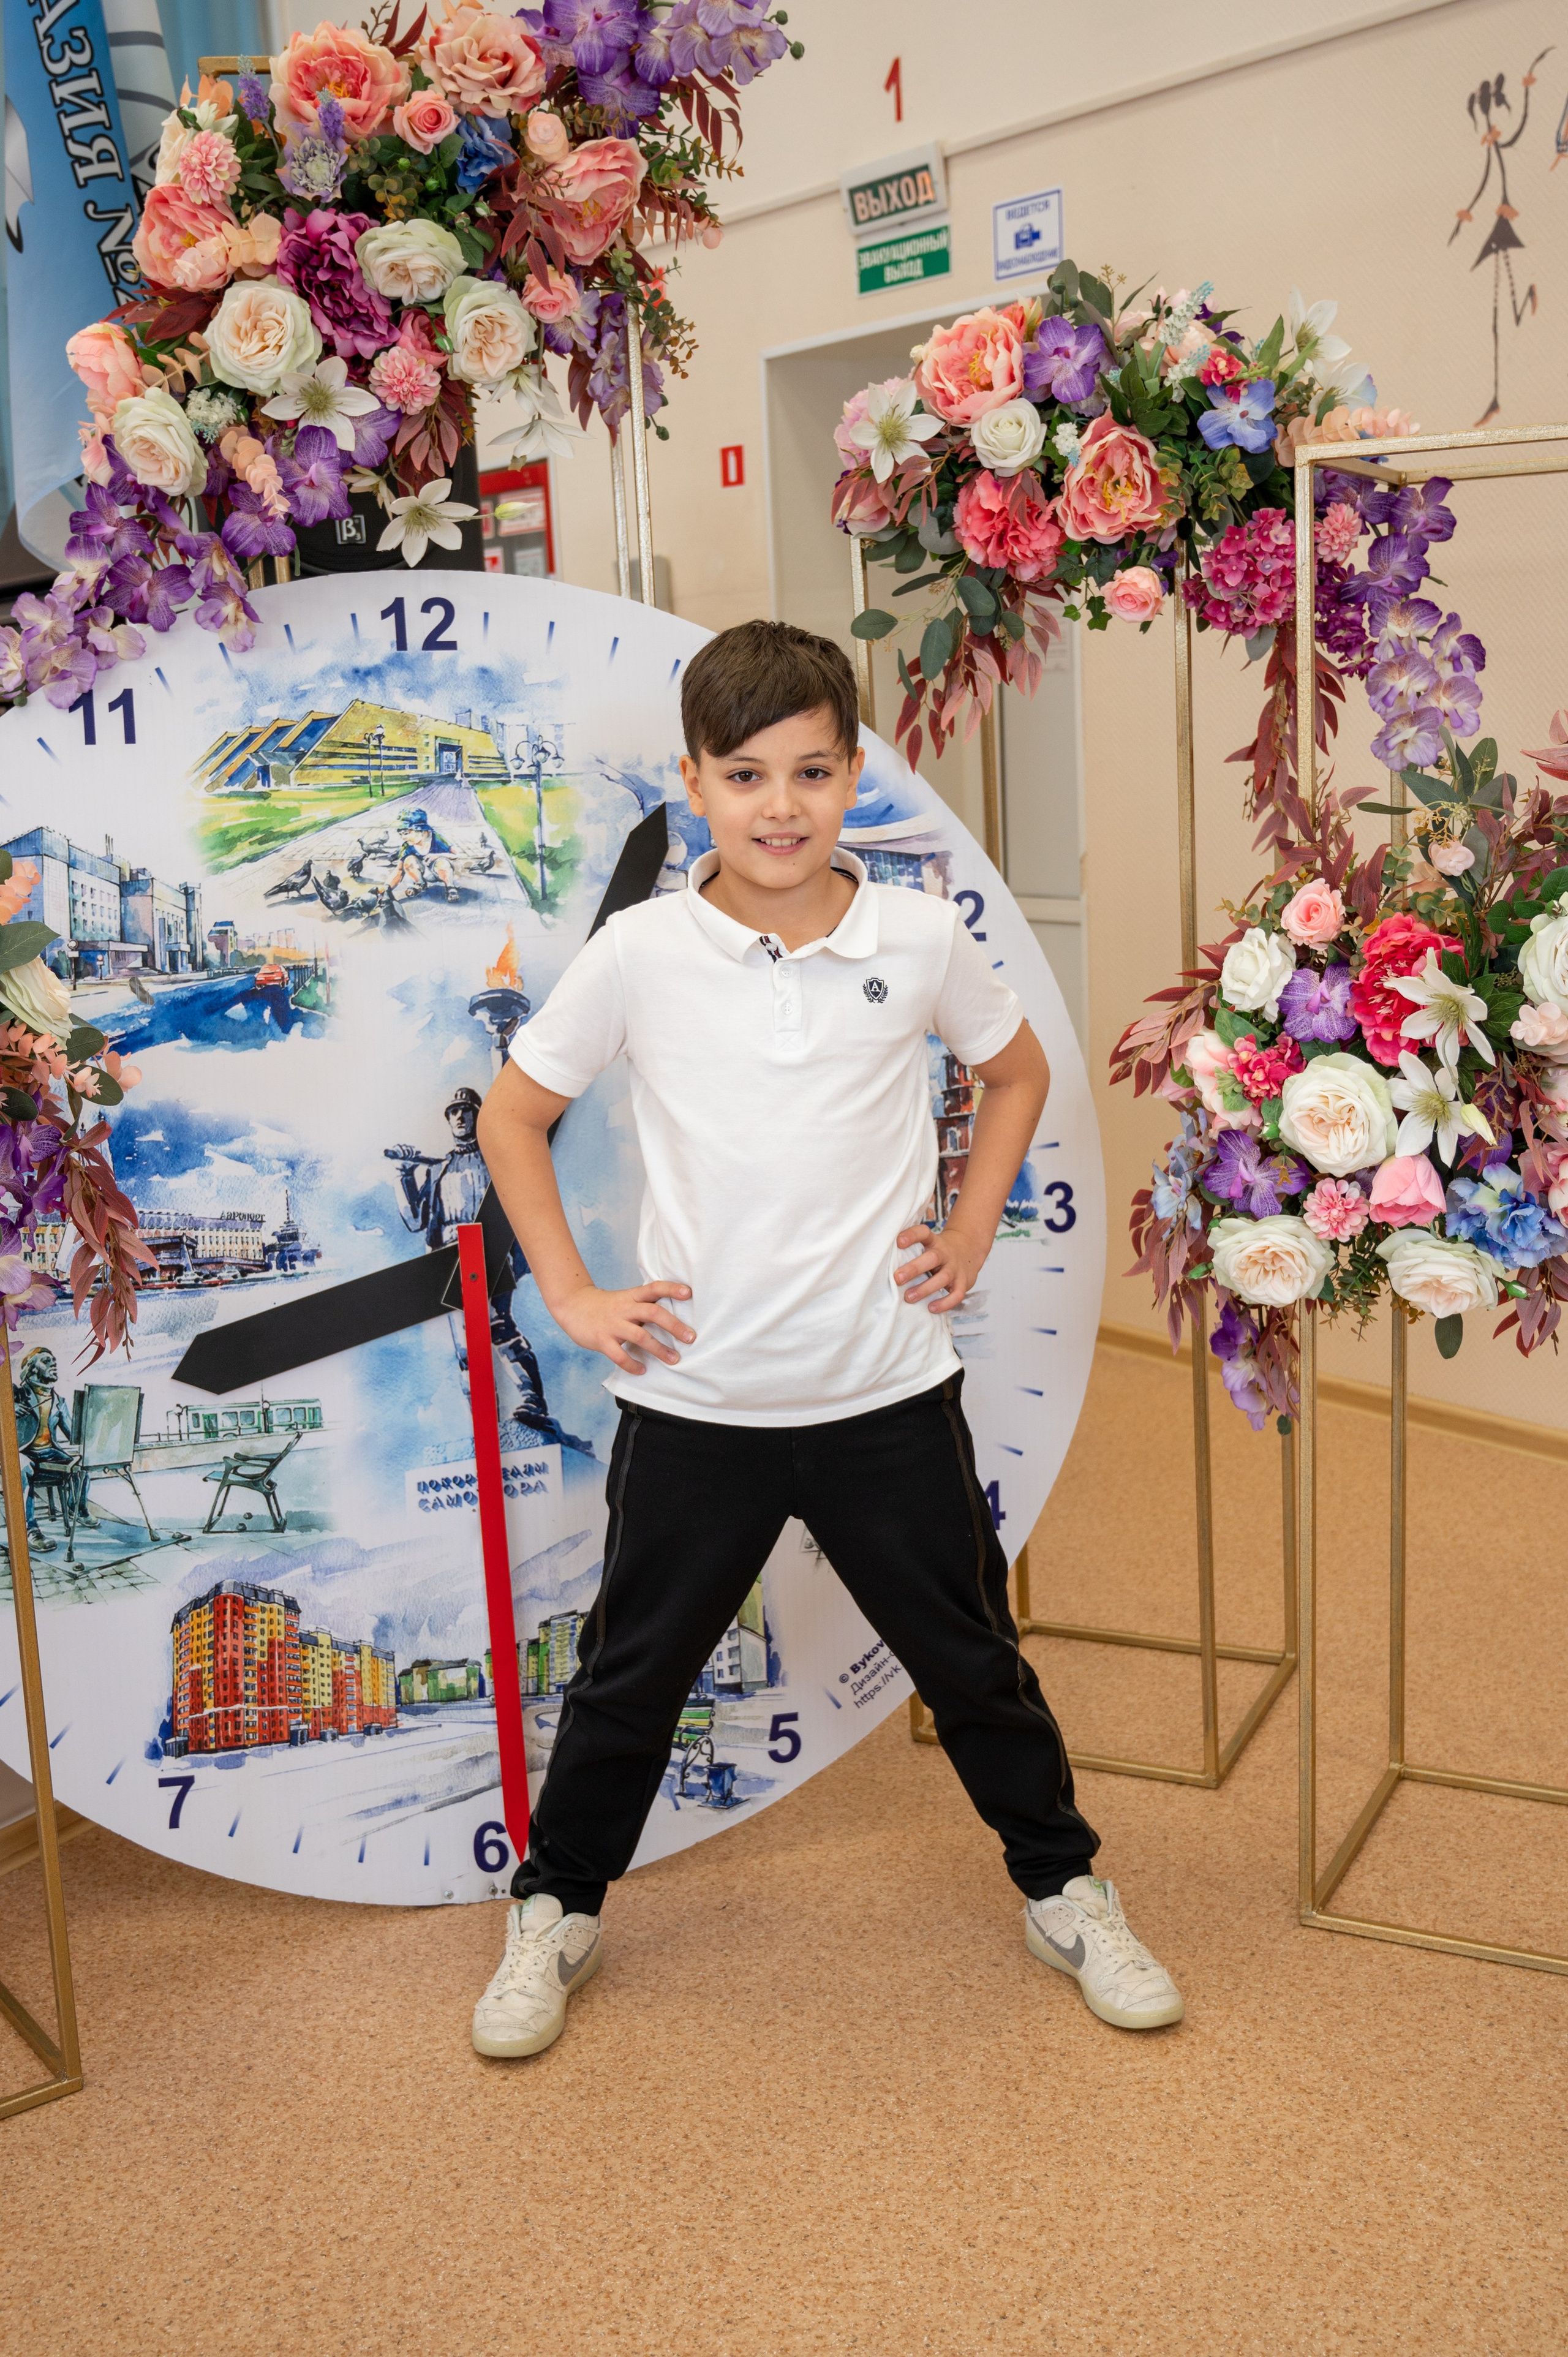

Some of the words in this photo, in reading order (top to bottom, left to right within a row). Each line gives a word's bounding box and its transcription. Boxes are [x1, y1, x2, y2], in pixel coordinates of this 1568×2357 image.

[853, 170, 935, 221] ВЫХОД
[859, 229, 948, 270] ЭВАКУАЦИОННЫЙ
[884, 257, 924, 284] ВЫХОД
[381, 597, 458, 651] 12
[69, 688, 137, 745] 11
[953, 890, 987, 941] 2
[870, 981, 881, 992] A
[1044, 1181, 1076, 1233] 3
[767, 1711, 801, 1763] 5
[157, 1775, 195, 1830] 7
[473, 1820, 510, 1873] 6
